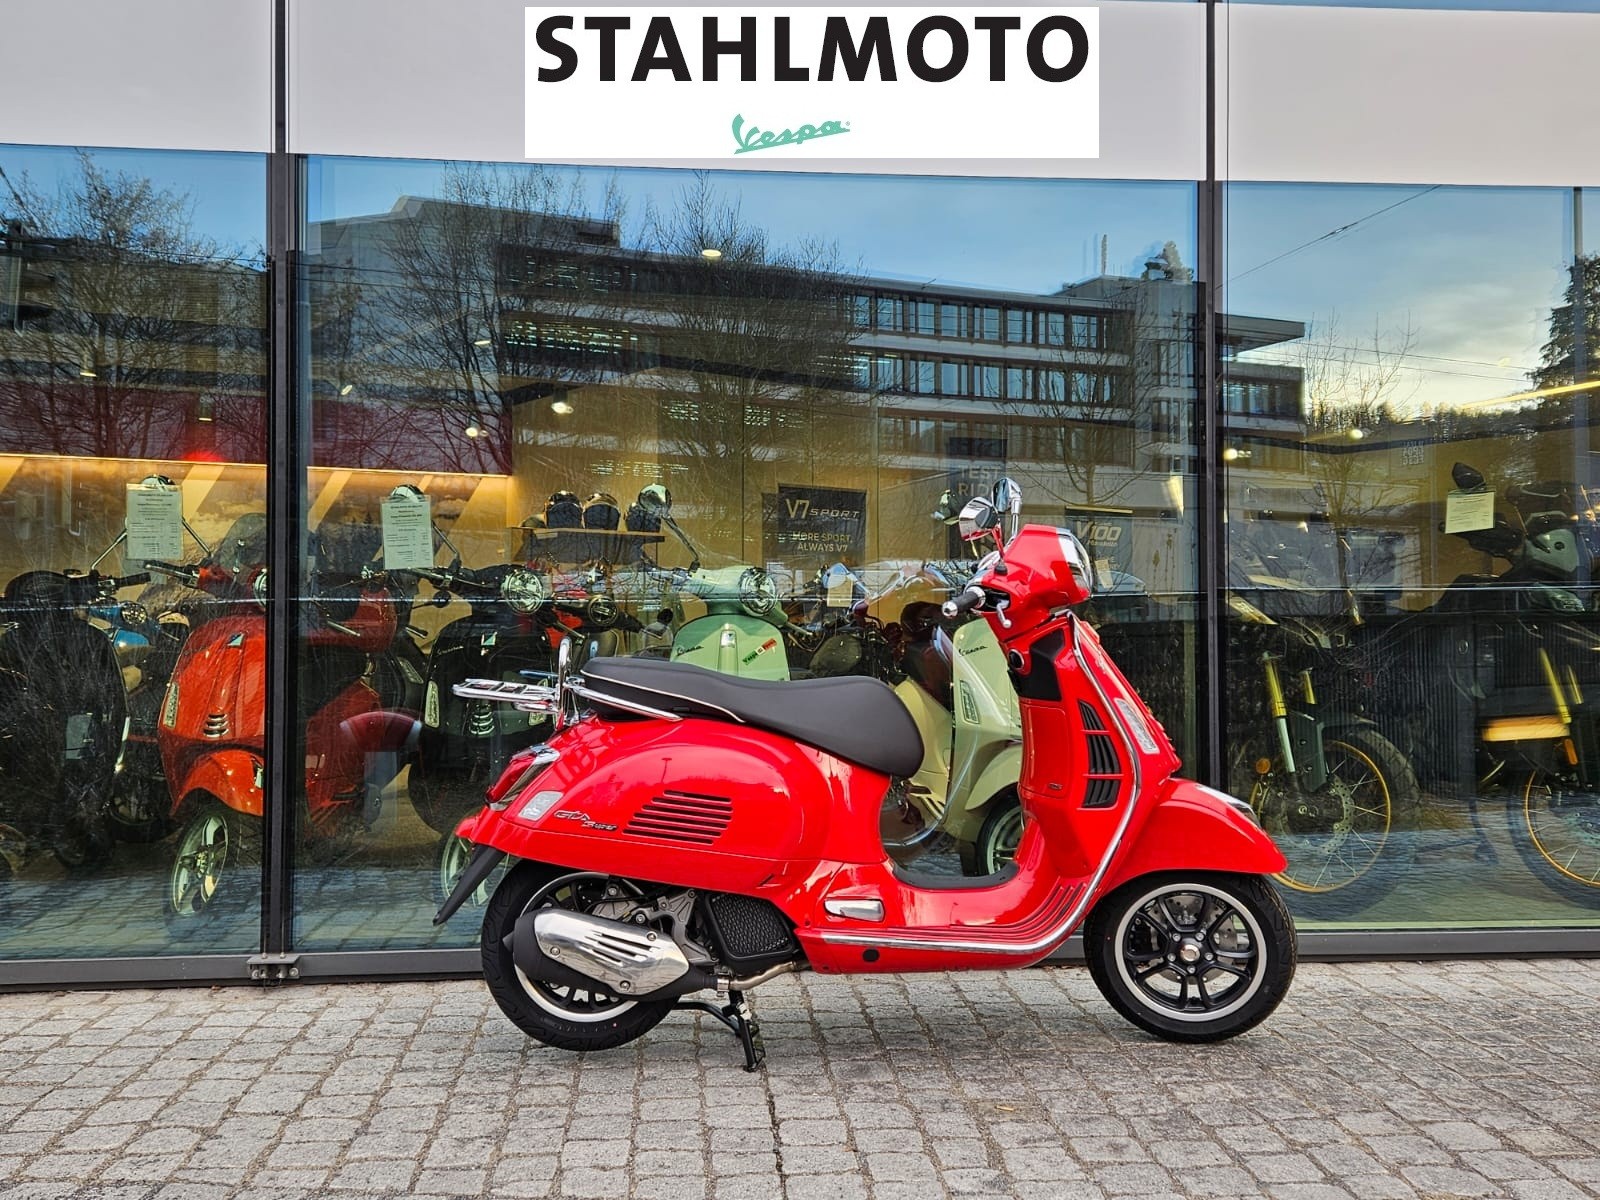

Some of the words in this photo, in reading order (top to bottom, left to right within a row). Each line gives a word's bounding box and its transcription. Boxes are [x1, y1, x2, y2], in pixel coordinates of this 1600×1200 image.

[959, 466, 1001, 479] TEST
[958, 482, 993, 497] RID
[785, 498, 810, 519] V7
[809, 508, 860, 518] SPORT
[1076, 520, 1122, 541] V100
[797, 542, 834, 552] ALWAYS
[836, 544, 848, 552] V7
